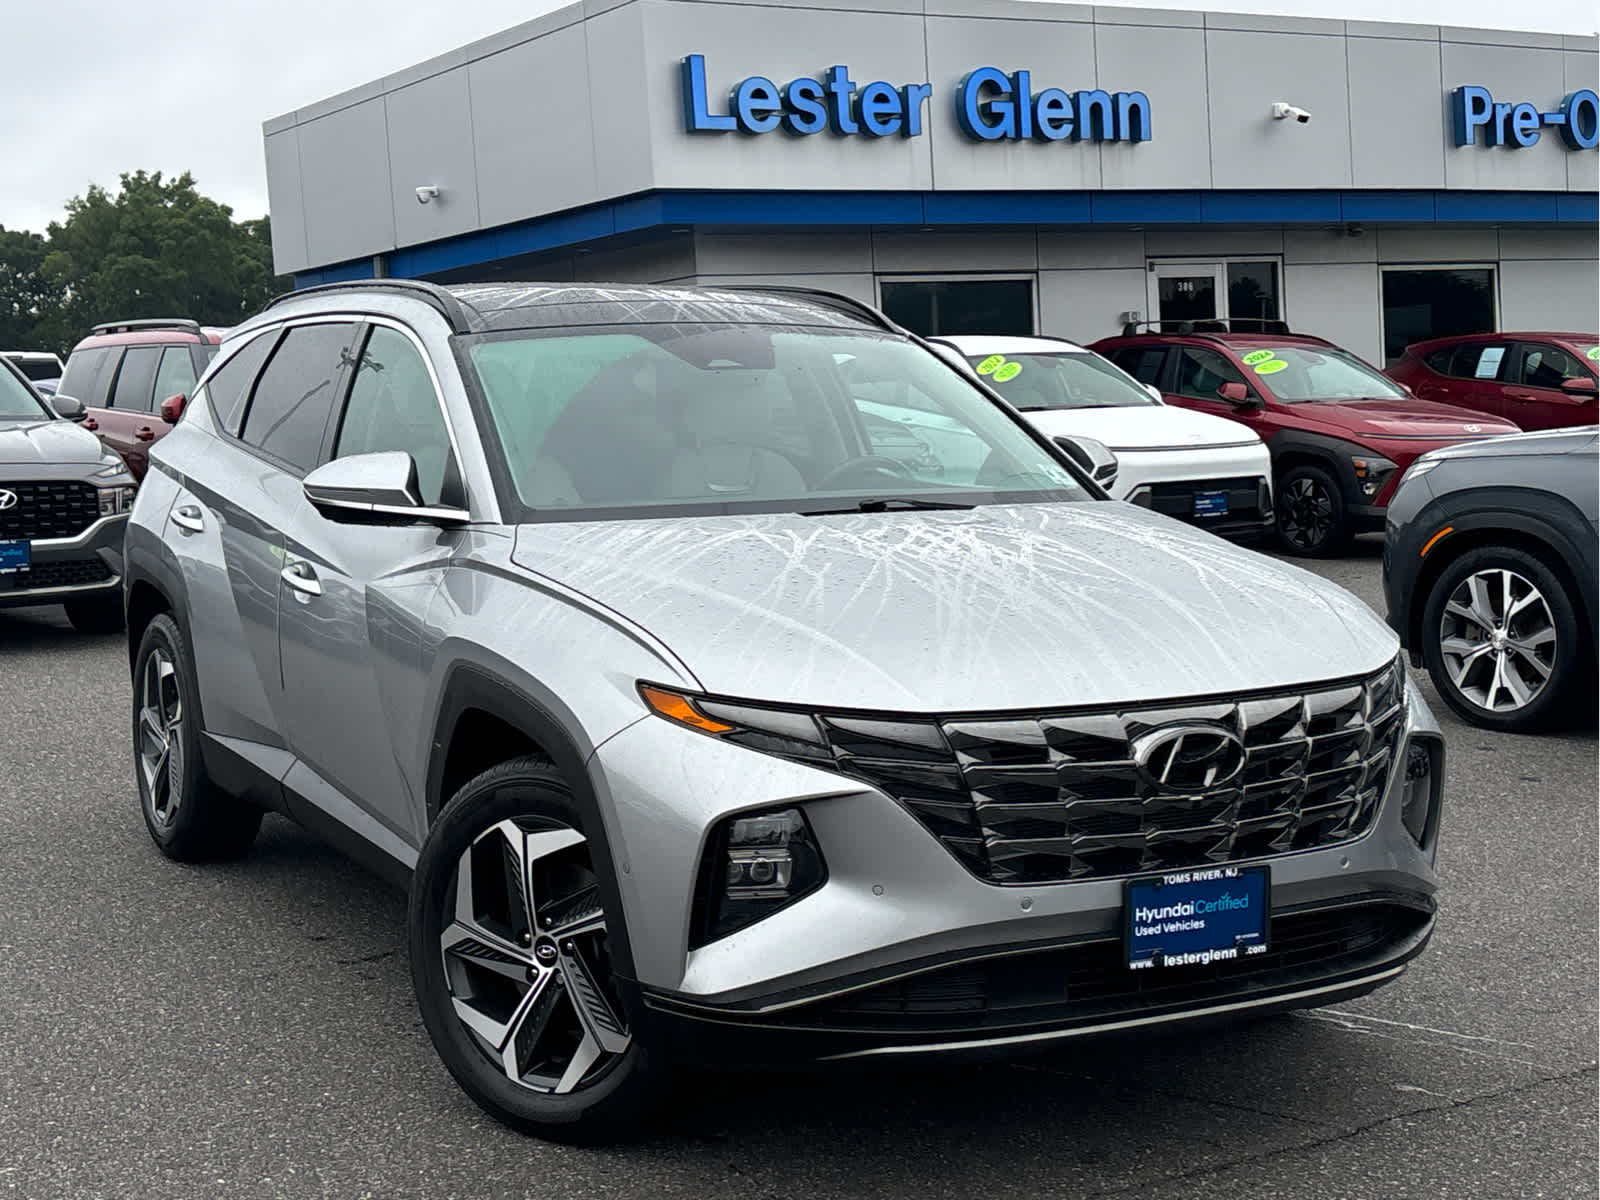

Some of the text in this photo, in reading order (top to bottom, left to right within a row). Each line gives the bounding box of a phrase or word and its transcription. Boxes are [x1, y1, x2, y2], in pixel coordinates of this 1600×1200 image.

[680, 54, 1152, 143] Lester Glenn
[1163, 867, 1238, 885] TOMS RIVER, NJ
[1135, 892, 1249, 923] Hyundai Certified
[1135, 919, 1205, 937] Used Vehicles
[1164, 948, 1237, 967] lesterglenn
